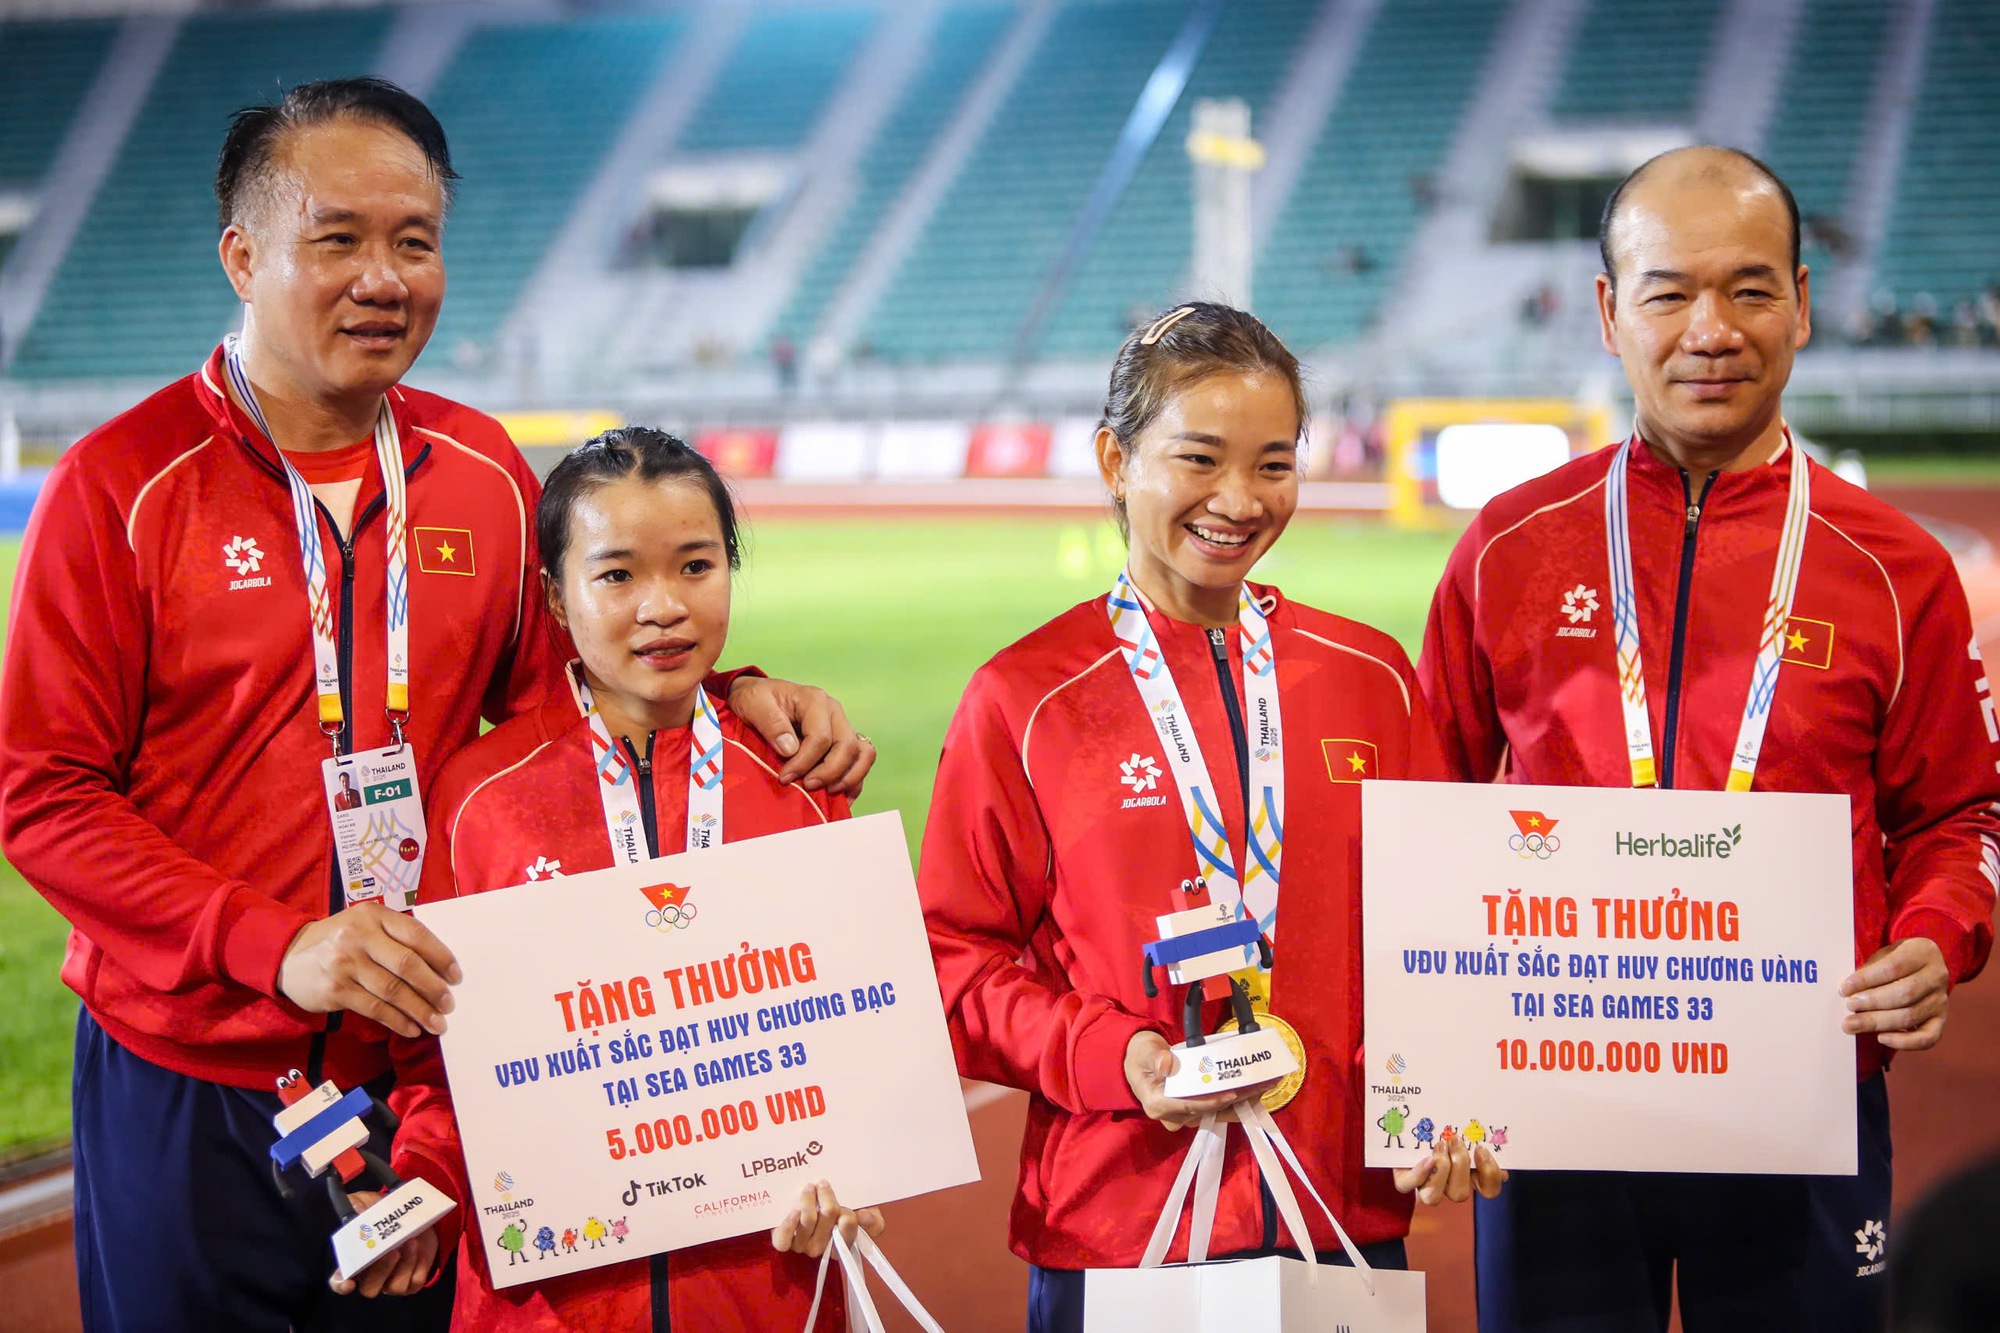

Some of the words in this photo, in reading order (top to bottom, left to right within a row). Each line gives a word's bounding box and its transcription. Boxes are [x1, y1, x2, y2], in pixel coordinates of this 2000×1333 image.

[1258, 697, 1270, 746] THAILAND
[1166, 713, 1191, 763] THAILAND
[371, 762, 406, 776] THAILAND
[1120, 795, 1167, 809] JOGARBOLA
[623, 827, 639, 864] THAILA
[1616, 831, 1731, 859] Herbalife
[1482, 888, 1578, 946] TẶNG
[1591, 887, 1740, 943] THƯỞNG
[1403, 949, 1447, 975] VĐV
[1455, 943, 1510, 976] XUẤT
[1517, 945, 1561, 978] SẮC
[1568, 953, 1610, 985] ĐẠT
[1617, 955, 1659, 980] HUY
[1666, 955, 1754, 983] CHƯƠNG
[1761, 953, 1818, 984] VÀNG
[555, 975, 656, 1037] TẶNG
[663, 941, 817, 1010] THƯỞNG
[1511, 992, 1545, 1021] TẠI
[1553, 993, 1594, 1019] SEA
[1602, 994, 1680, 1021] GAMES
[1686, 996, 1713, 1021] 33
[495, 1057, 540, 1088] VĐV
[546, 1036, 601, 1078] XUẤT
[609, 1028, 653, 1065] SẮC
[659, 1022, 700, 1057] ĐẠT
[708, 1012, 749, 1044] HUY
[757, 992, 847, 1033] CHƯƠNG
[852, 981, 896, 1014] BẠC
[1216, 1050, 1272, 1071] THAILAND
[1496, 1038, 1661, 1074] 10.000.000
[1672, 1041, 1729, 1075] VND
[603, 1076, 640, 1108] TẠI
[645, 1067, 688, 1098] SEA
[693, 1048, 773, 1087] GAMES
[778, 1041, 807, 1069] 33
[1217, 1069, 1242, 1081] 2025
[1371, 1085, 1422, 1095] THAILAND
[606, 1099, 759, 1161] 5.000.000
[765, 1085, 826, 1125] VND
[741, 1151, 809, 1179] LPBank
[645, 1172, 708, 1198] TikTok
[373, 1195, 424, 1231] THAILAND
[484, 1198, 534, 1216] THAILAND
[694, 1190, 771, 1214] CALIFORNIA
[379, 1221, 402, 1240] 2025
